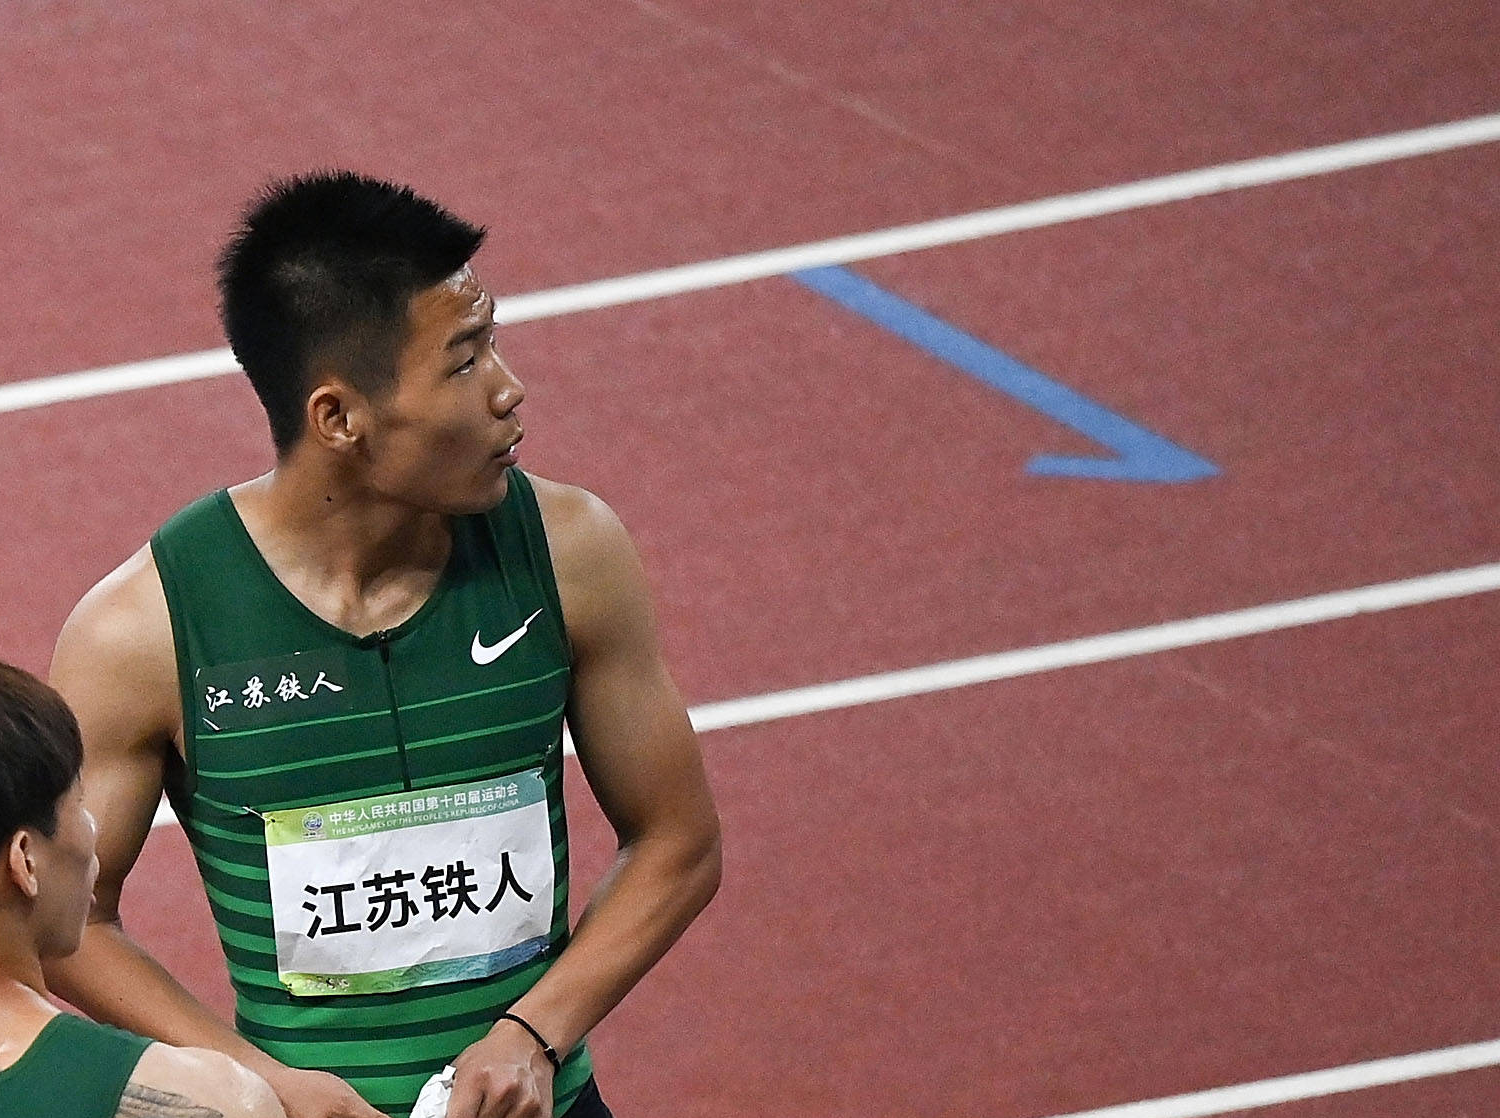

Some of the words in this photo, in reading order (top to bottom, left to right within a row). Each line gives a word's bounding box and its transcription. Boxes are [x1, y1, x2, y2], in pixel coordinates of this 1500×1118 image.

[206, 671, 344, 712] 江苏铁人
[329, 782, 518, 825] 中华人民共和国第十四届运动会
[301, 852, 534, 939] 江苏铁人
